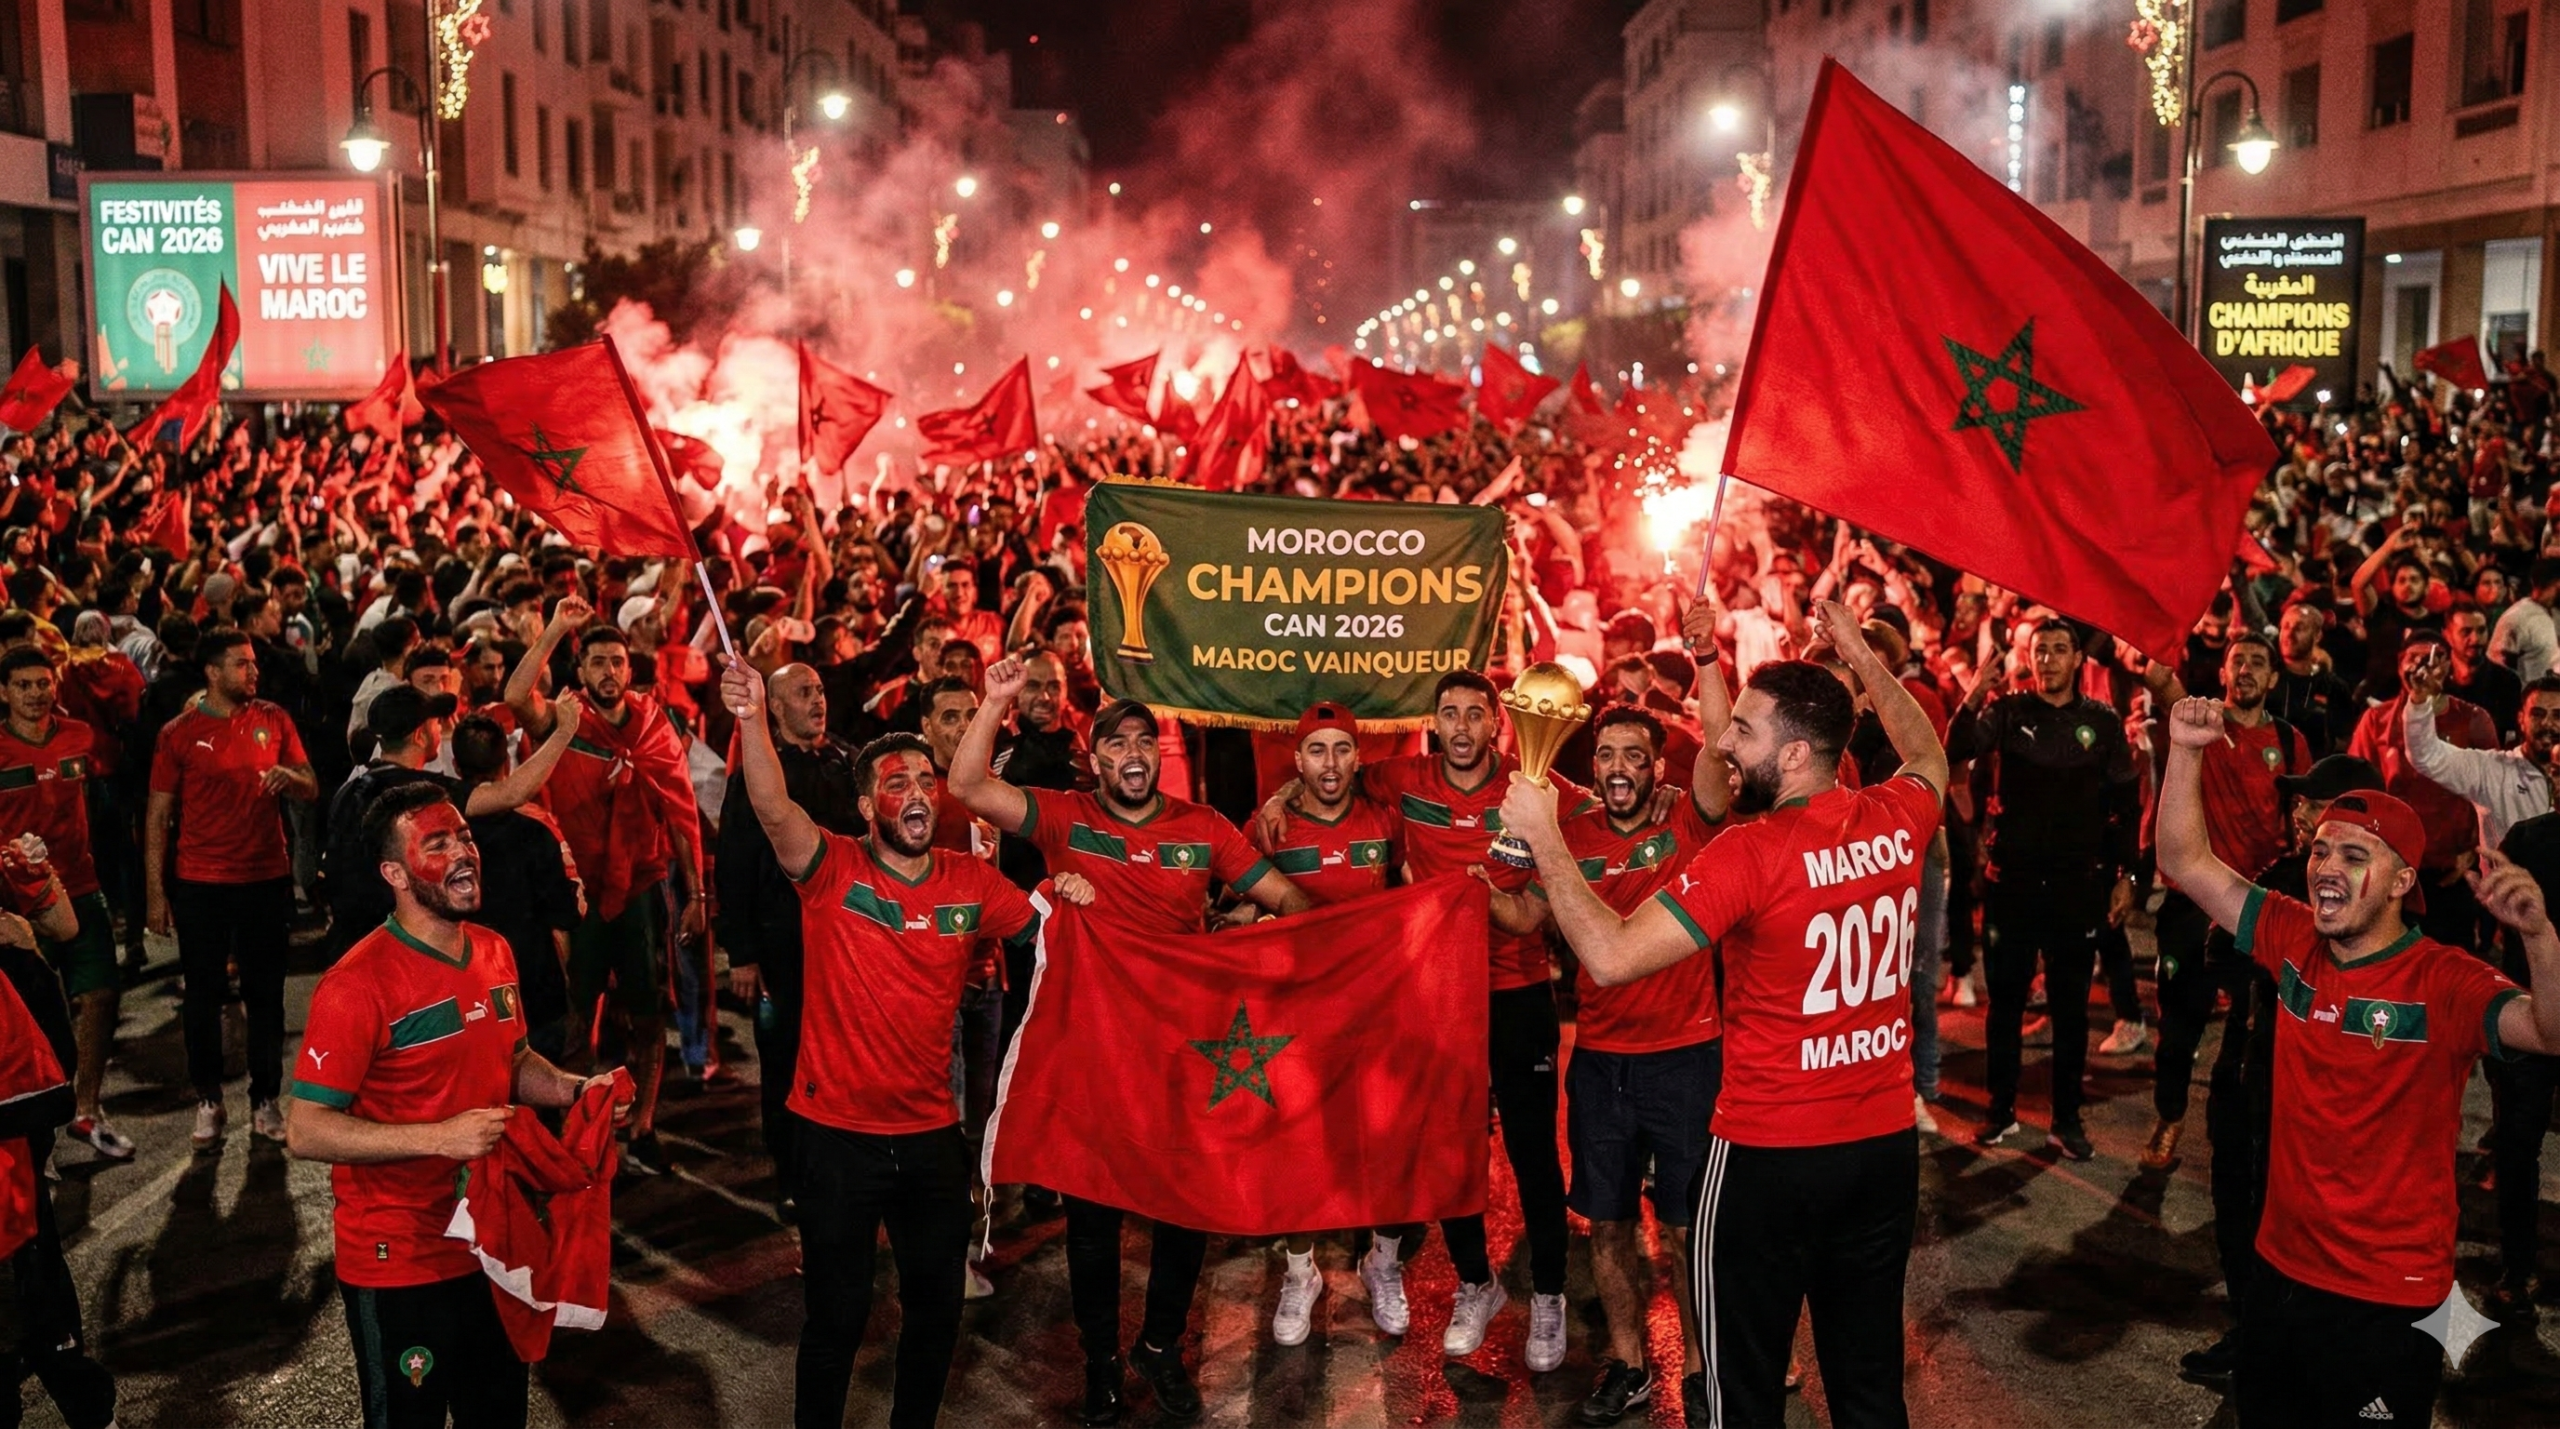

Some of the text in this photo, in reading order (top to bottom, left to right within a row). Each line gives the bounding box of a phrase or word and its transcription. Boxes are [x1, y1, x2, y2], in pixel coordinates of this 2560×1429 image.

[100, 194, 222, 224] FESTIVITÉS
[101, 226, 224, 254] CAN 2026
[257, 252, 367, 284] VIVE LE
[260, 287, 367, 320] MAROC
[2208, 301, 2350, 328] CHAMPIONS
[2216, 329, 2341, 358] D'AFRIQUE
[1247, 527, 1426, 556] MOROCCO
[1186, 563, 1483, 605] CHAMPIONS
[1263, 612, 1405, 639] CAN 2026
[1192, 645, 1471, 678] MAROC VAINQUEUR
[1802, 828, 1914, 889] MAROC
[1802, 886, 1918, 1016] 2026
[1801, 1017, 1907, 1071] MAROC
